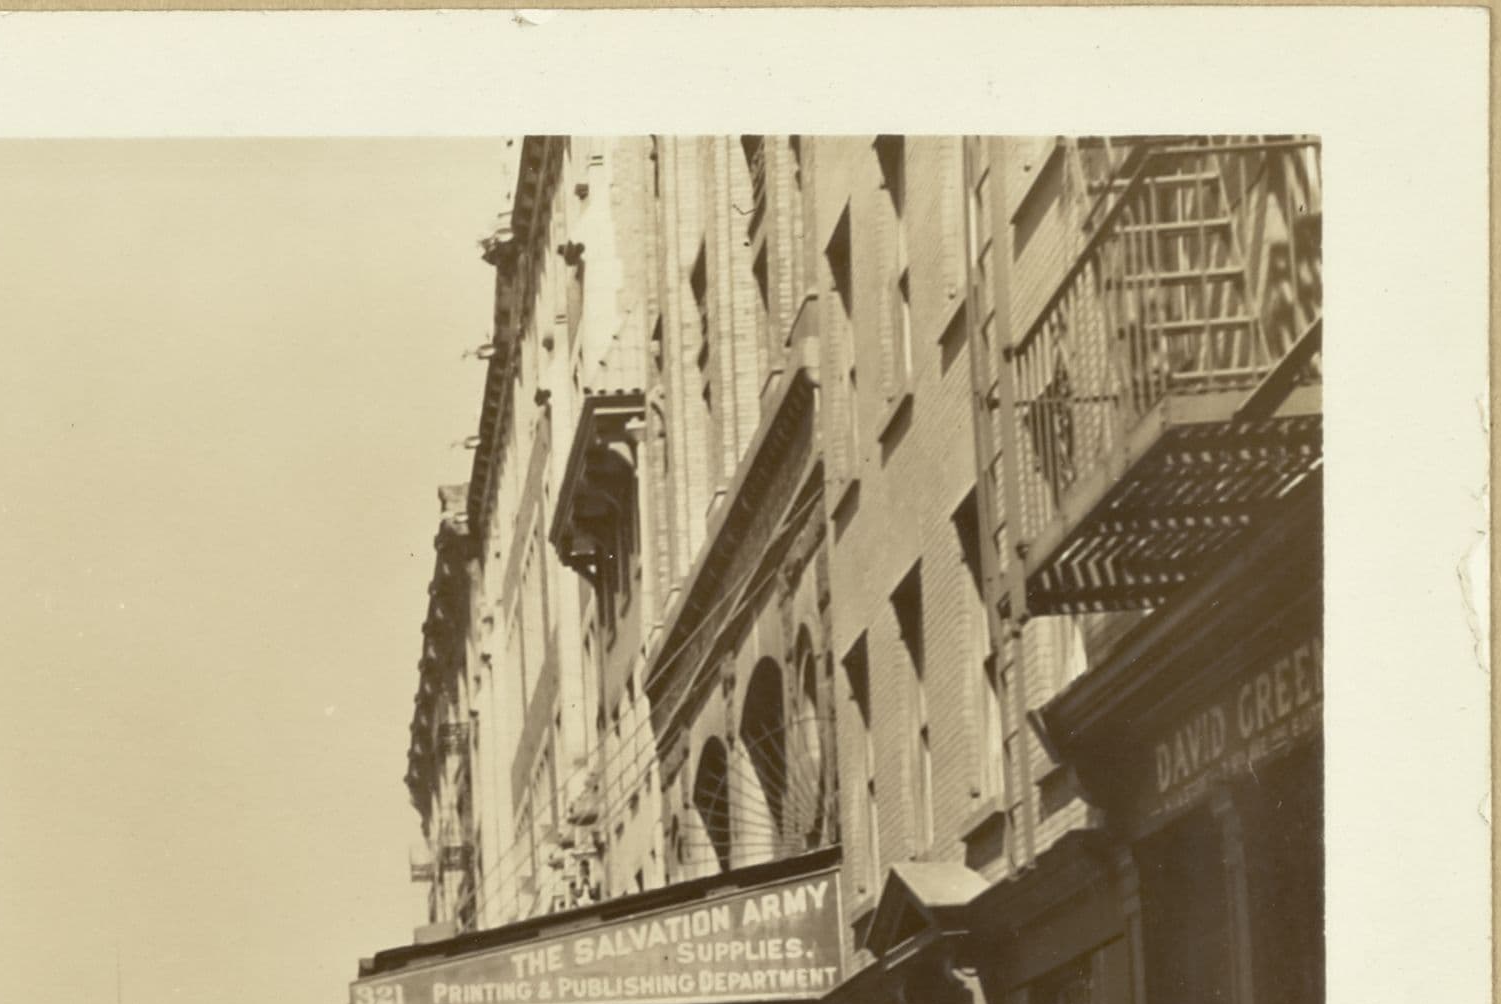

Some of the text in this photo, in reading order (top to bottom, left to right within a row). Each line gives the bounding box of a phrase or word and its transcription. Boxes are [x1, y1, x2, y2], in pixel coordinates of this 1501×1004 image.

[1155, 705, 1226, 793] DAVID
[511, 881, 828, 978] THE SALVATION ARMY
[676, 937, 814, 964] SUPPLIES.
[537, 981, 551, 1000] &
[558, 973, 695, 998] PUBLISHING
[700, 967, 837, 993] DEPARTMENT
